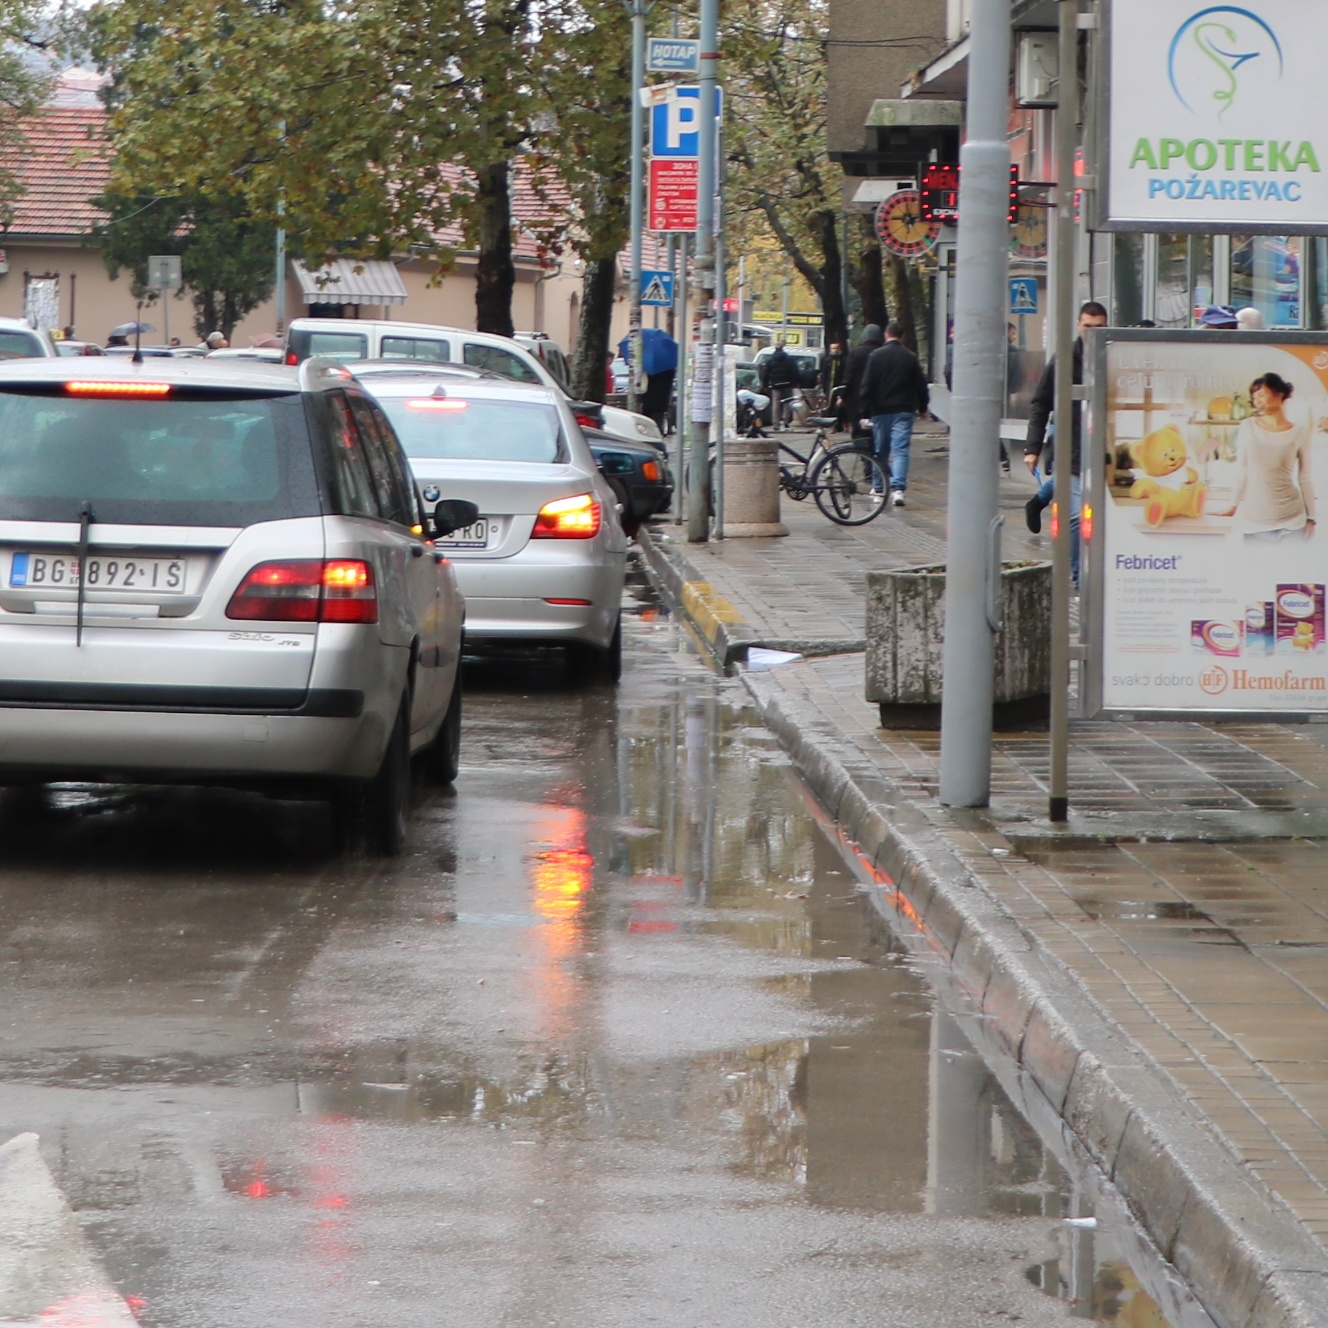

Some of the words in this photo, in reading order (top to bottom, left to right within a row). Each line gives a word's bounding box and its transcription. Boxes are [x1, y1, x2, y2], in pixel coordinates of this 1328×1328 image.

[667, 96, 701, 149] P
[1128, 137, 1321, 173] APOTEKA
[1147, 172, 1302, 203] POŽAREVAC
[32, 558, 65, 584] BG
[1155, 673, 1194, 687] dobro
[1232, 669, 1327, 691] Hemofarm
